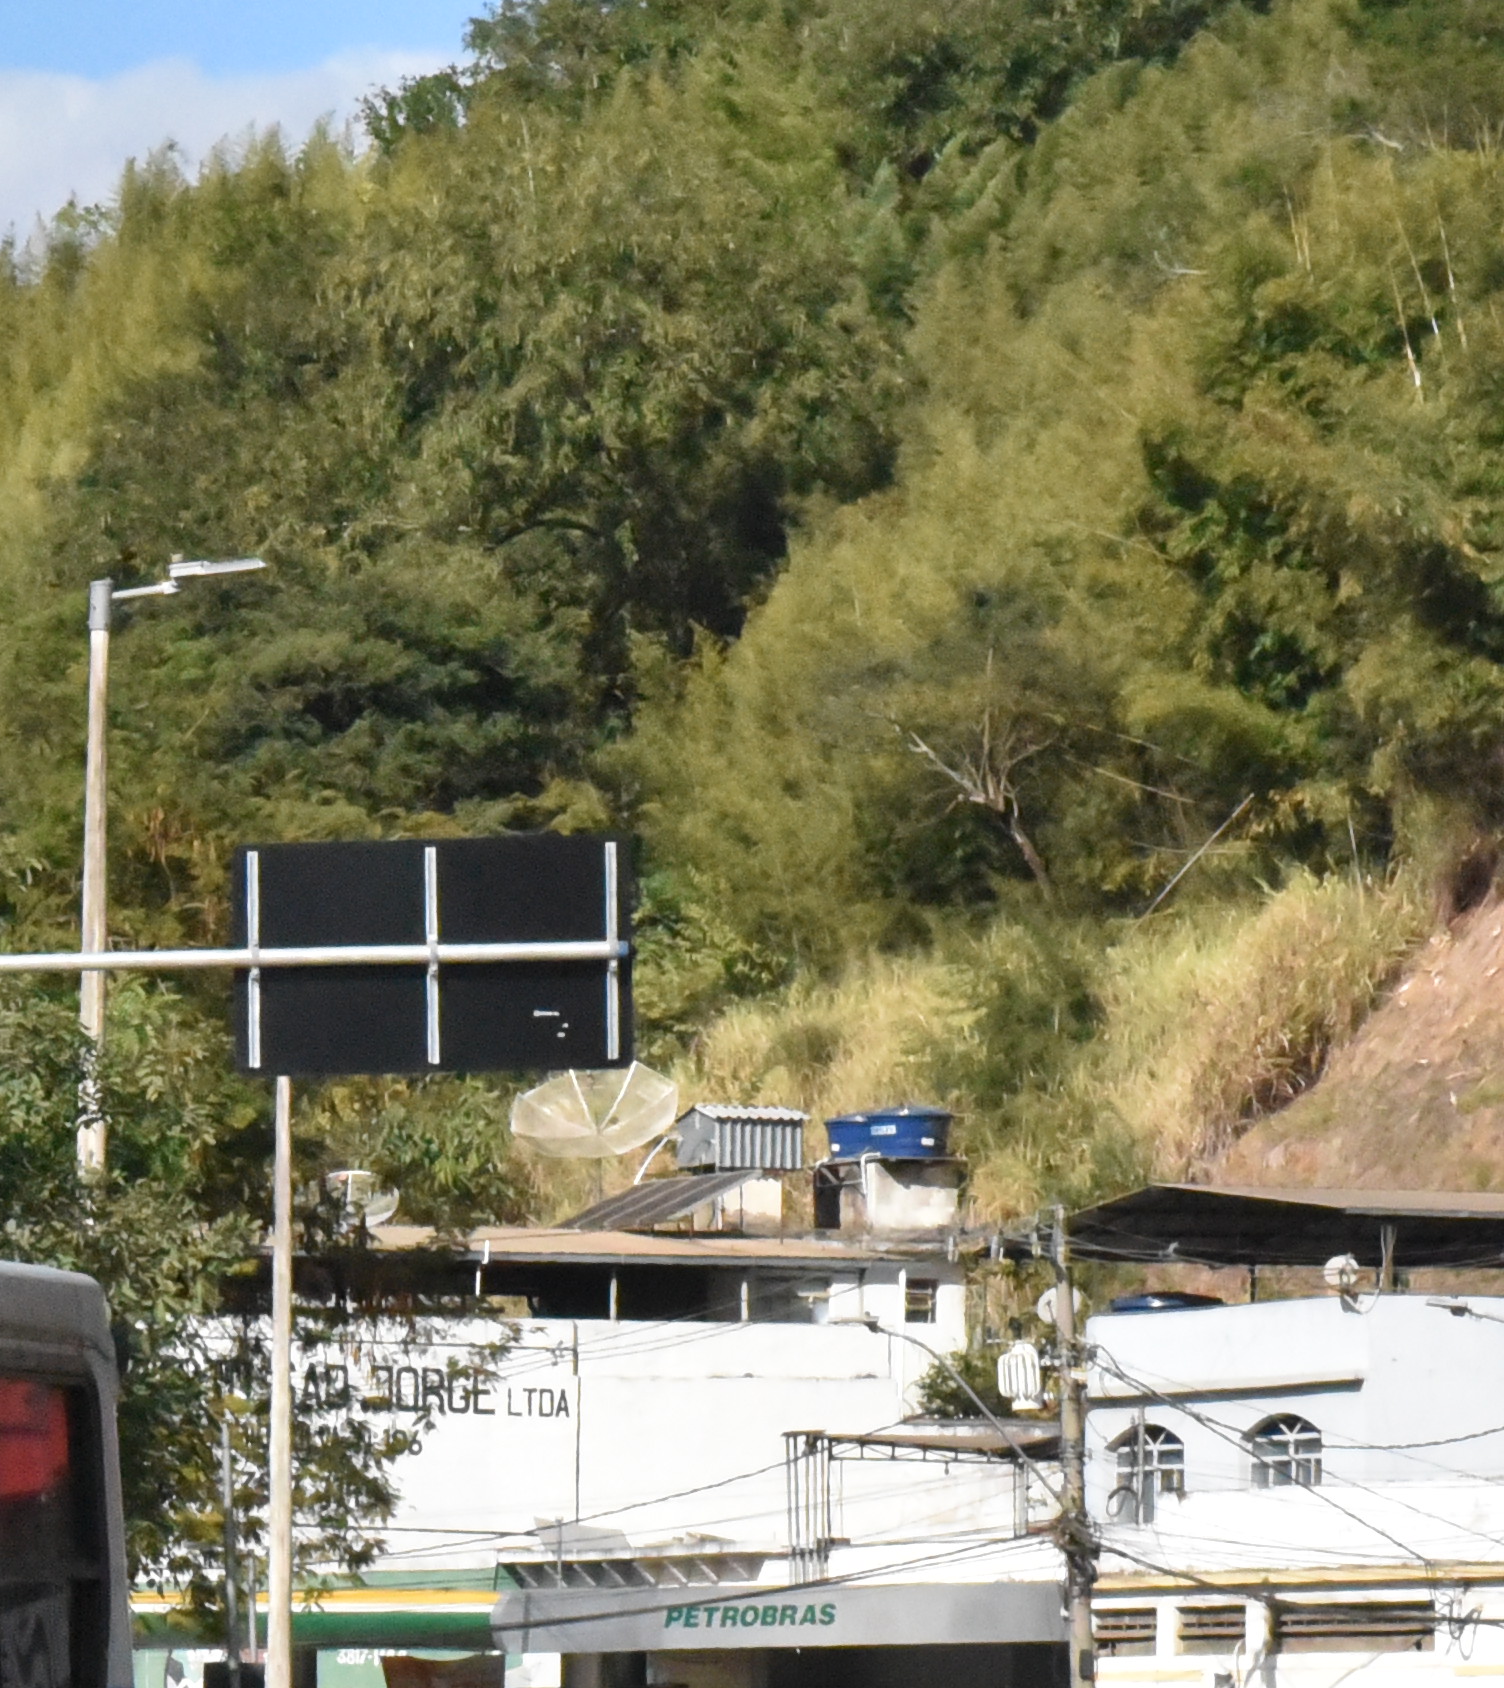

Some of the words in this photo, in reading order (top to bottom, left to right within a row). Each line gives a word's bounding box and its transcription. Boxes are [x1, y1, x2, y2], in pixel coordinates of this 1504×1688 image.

[360, 1364, 496, 1416] JORGE
[506, 1387, 570, 1419] LTDA
[663, 1602, 837, 1629] PETROBRAS
